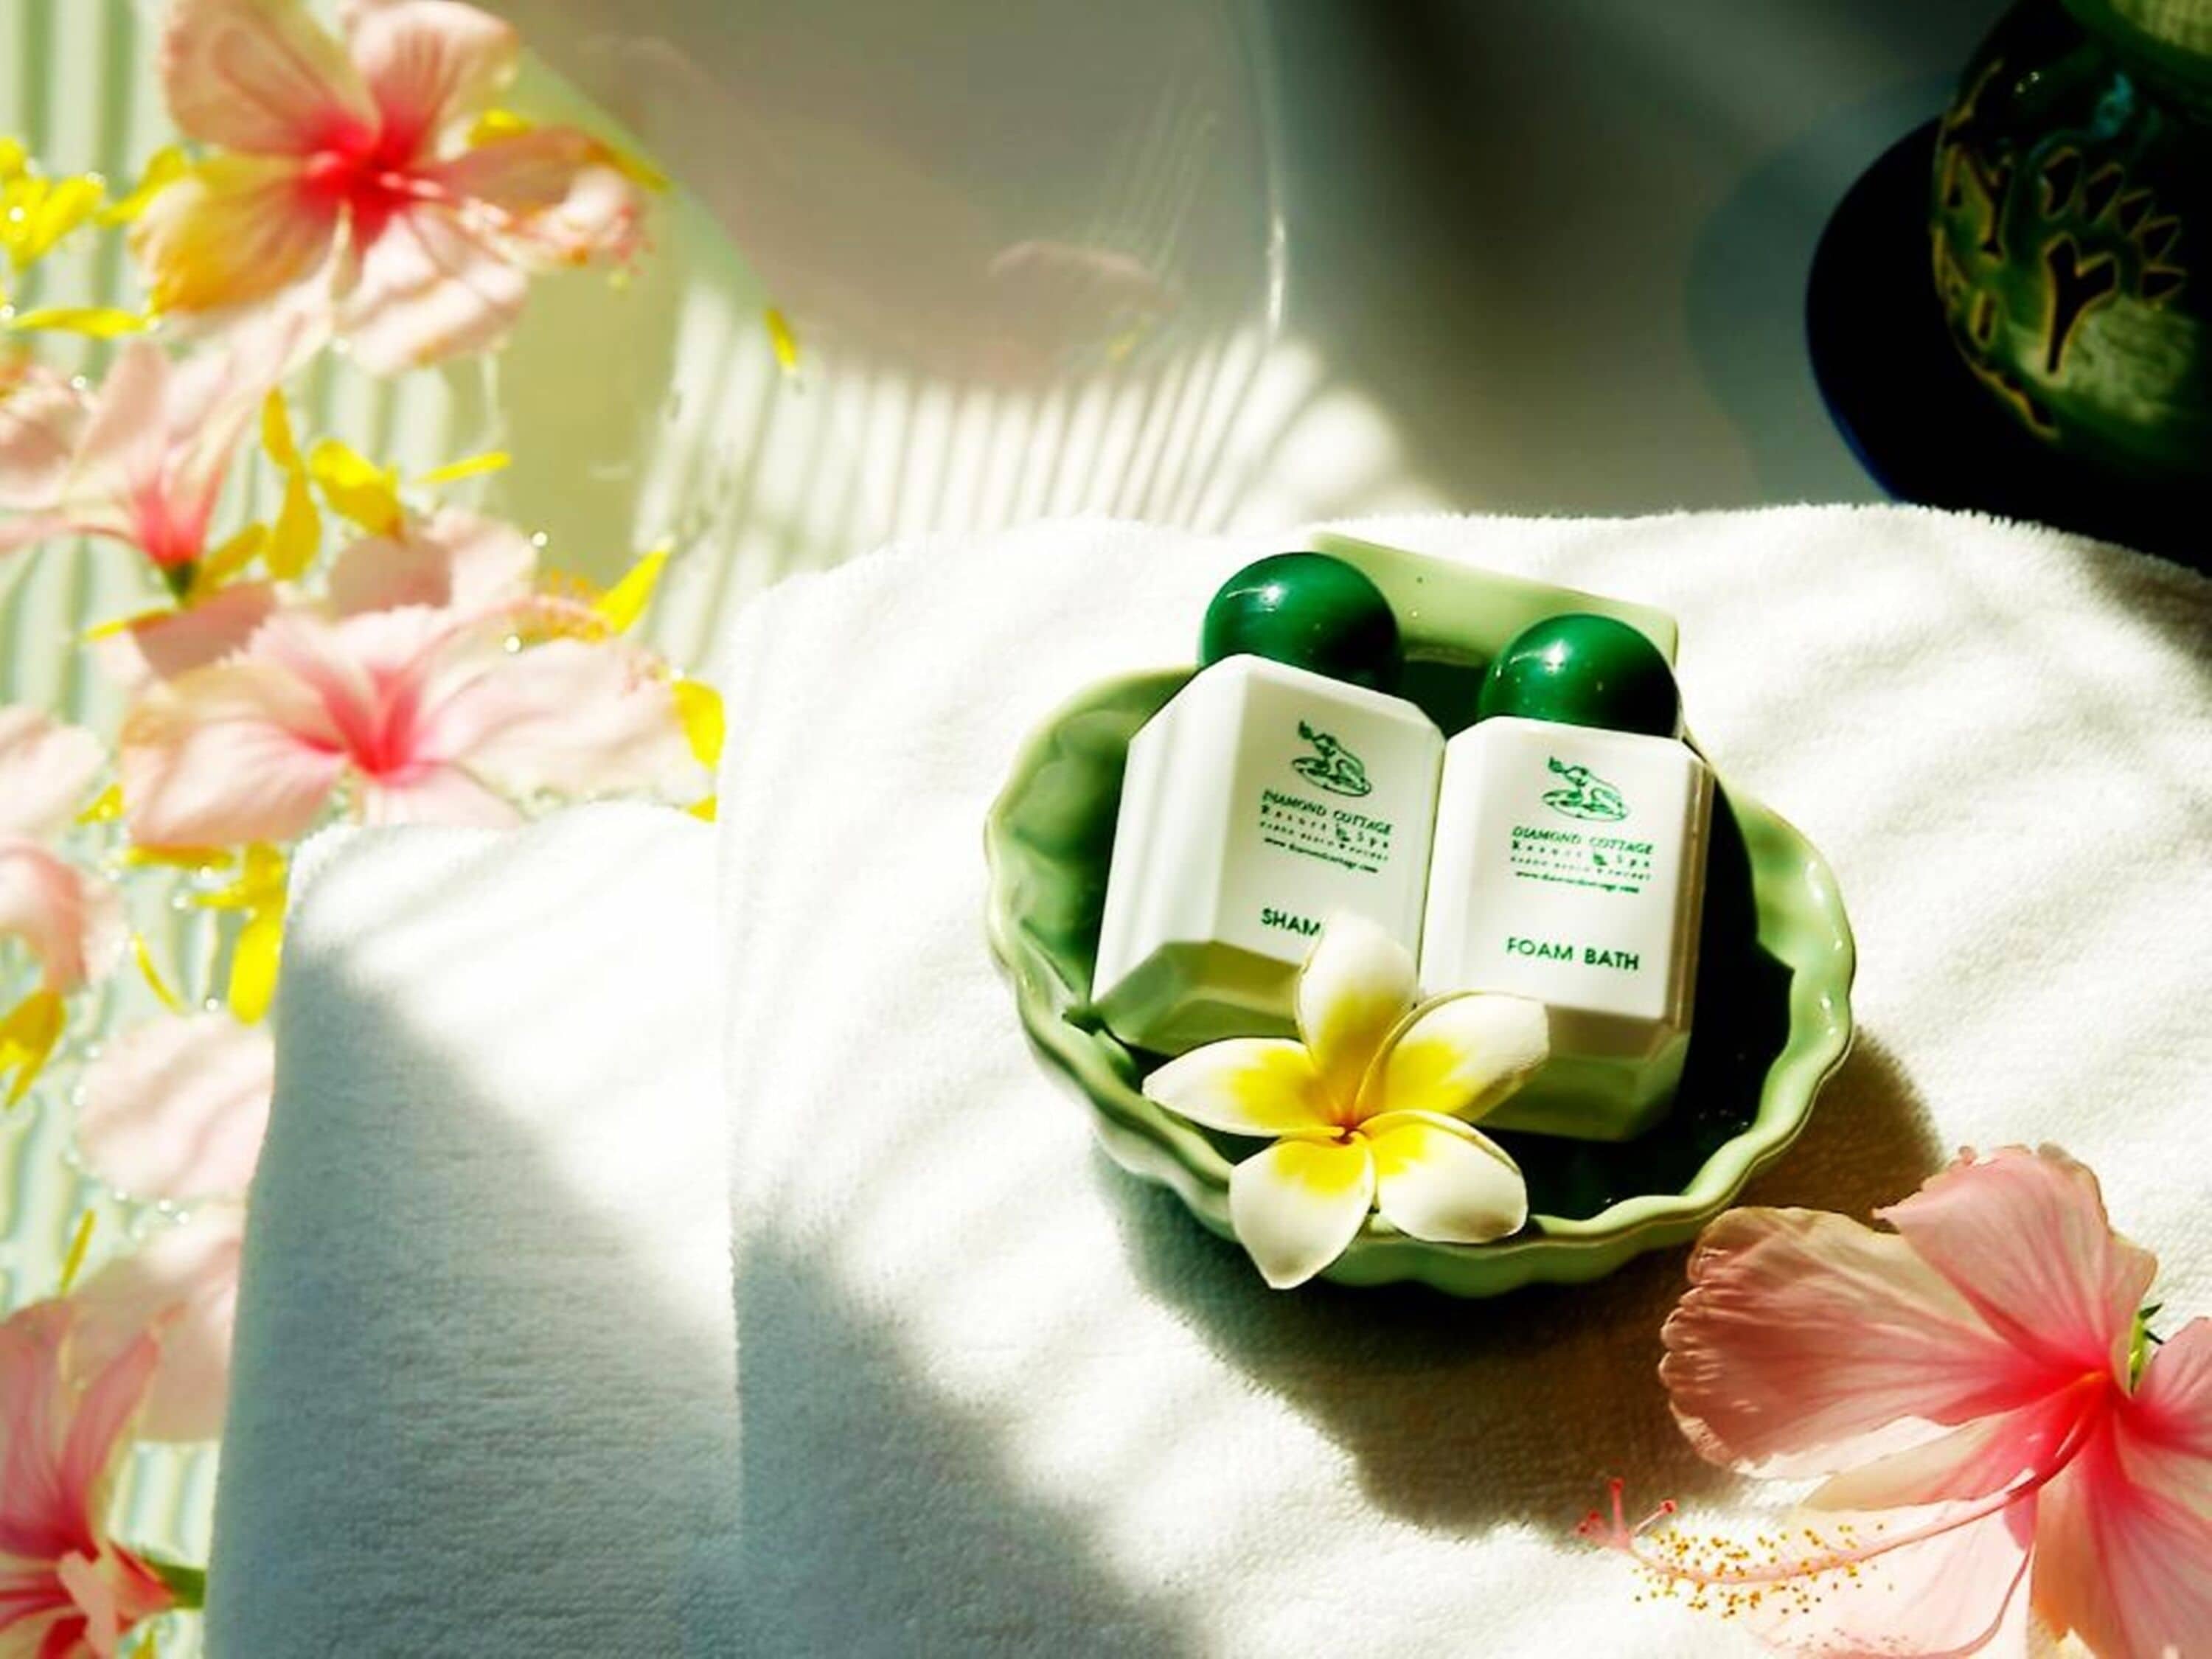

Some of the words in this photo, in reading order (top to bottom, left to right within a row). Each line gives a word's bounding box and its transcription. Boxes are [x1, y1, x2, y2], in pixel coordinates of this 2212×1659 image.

[1512, 826, 1582, 844] DIAMOND
[1590, 837, 1653, 855] COTTAGE
[1261, 907, 1321, 936] SHAM
[1506, 936, 1573, 961] FOAM
[1583, 947, 1639, 970] BATH
